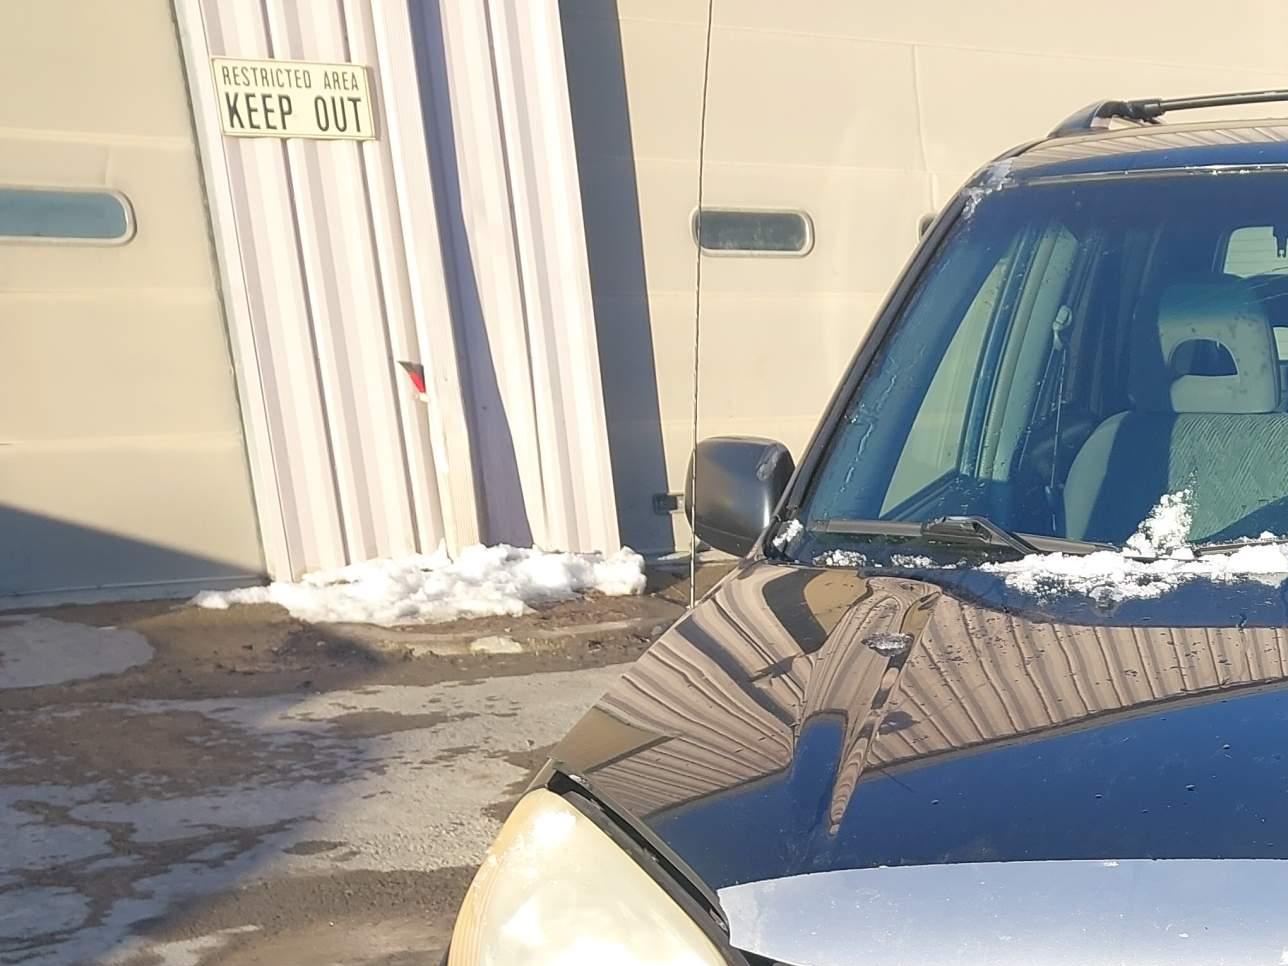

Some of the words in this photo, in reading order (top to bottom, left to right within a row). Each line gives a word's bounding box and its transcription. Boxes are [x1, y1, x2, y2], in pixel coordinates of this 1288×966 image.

[222, 65, 312, 89] RESTRICTED
[323, 71, 359, 91] AREA
[225, 92, 293, 130] KEEP
[314, 95, 362, 132] OUT
